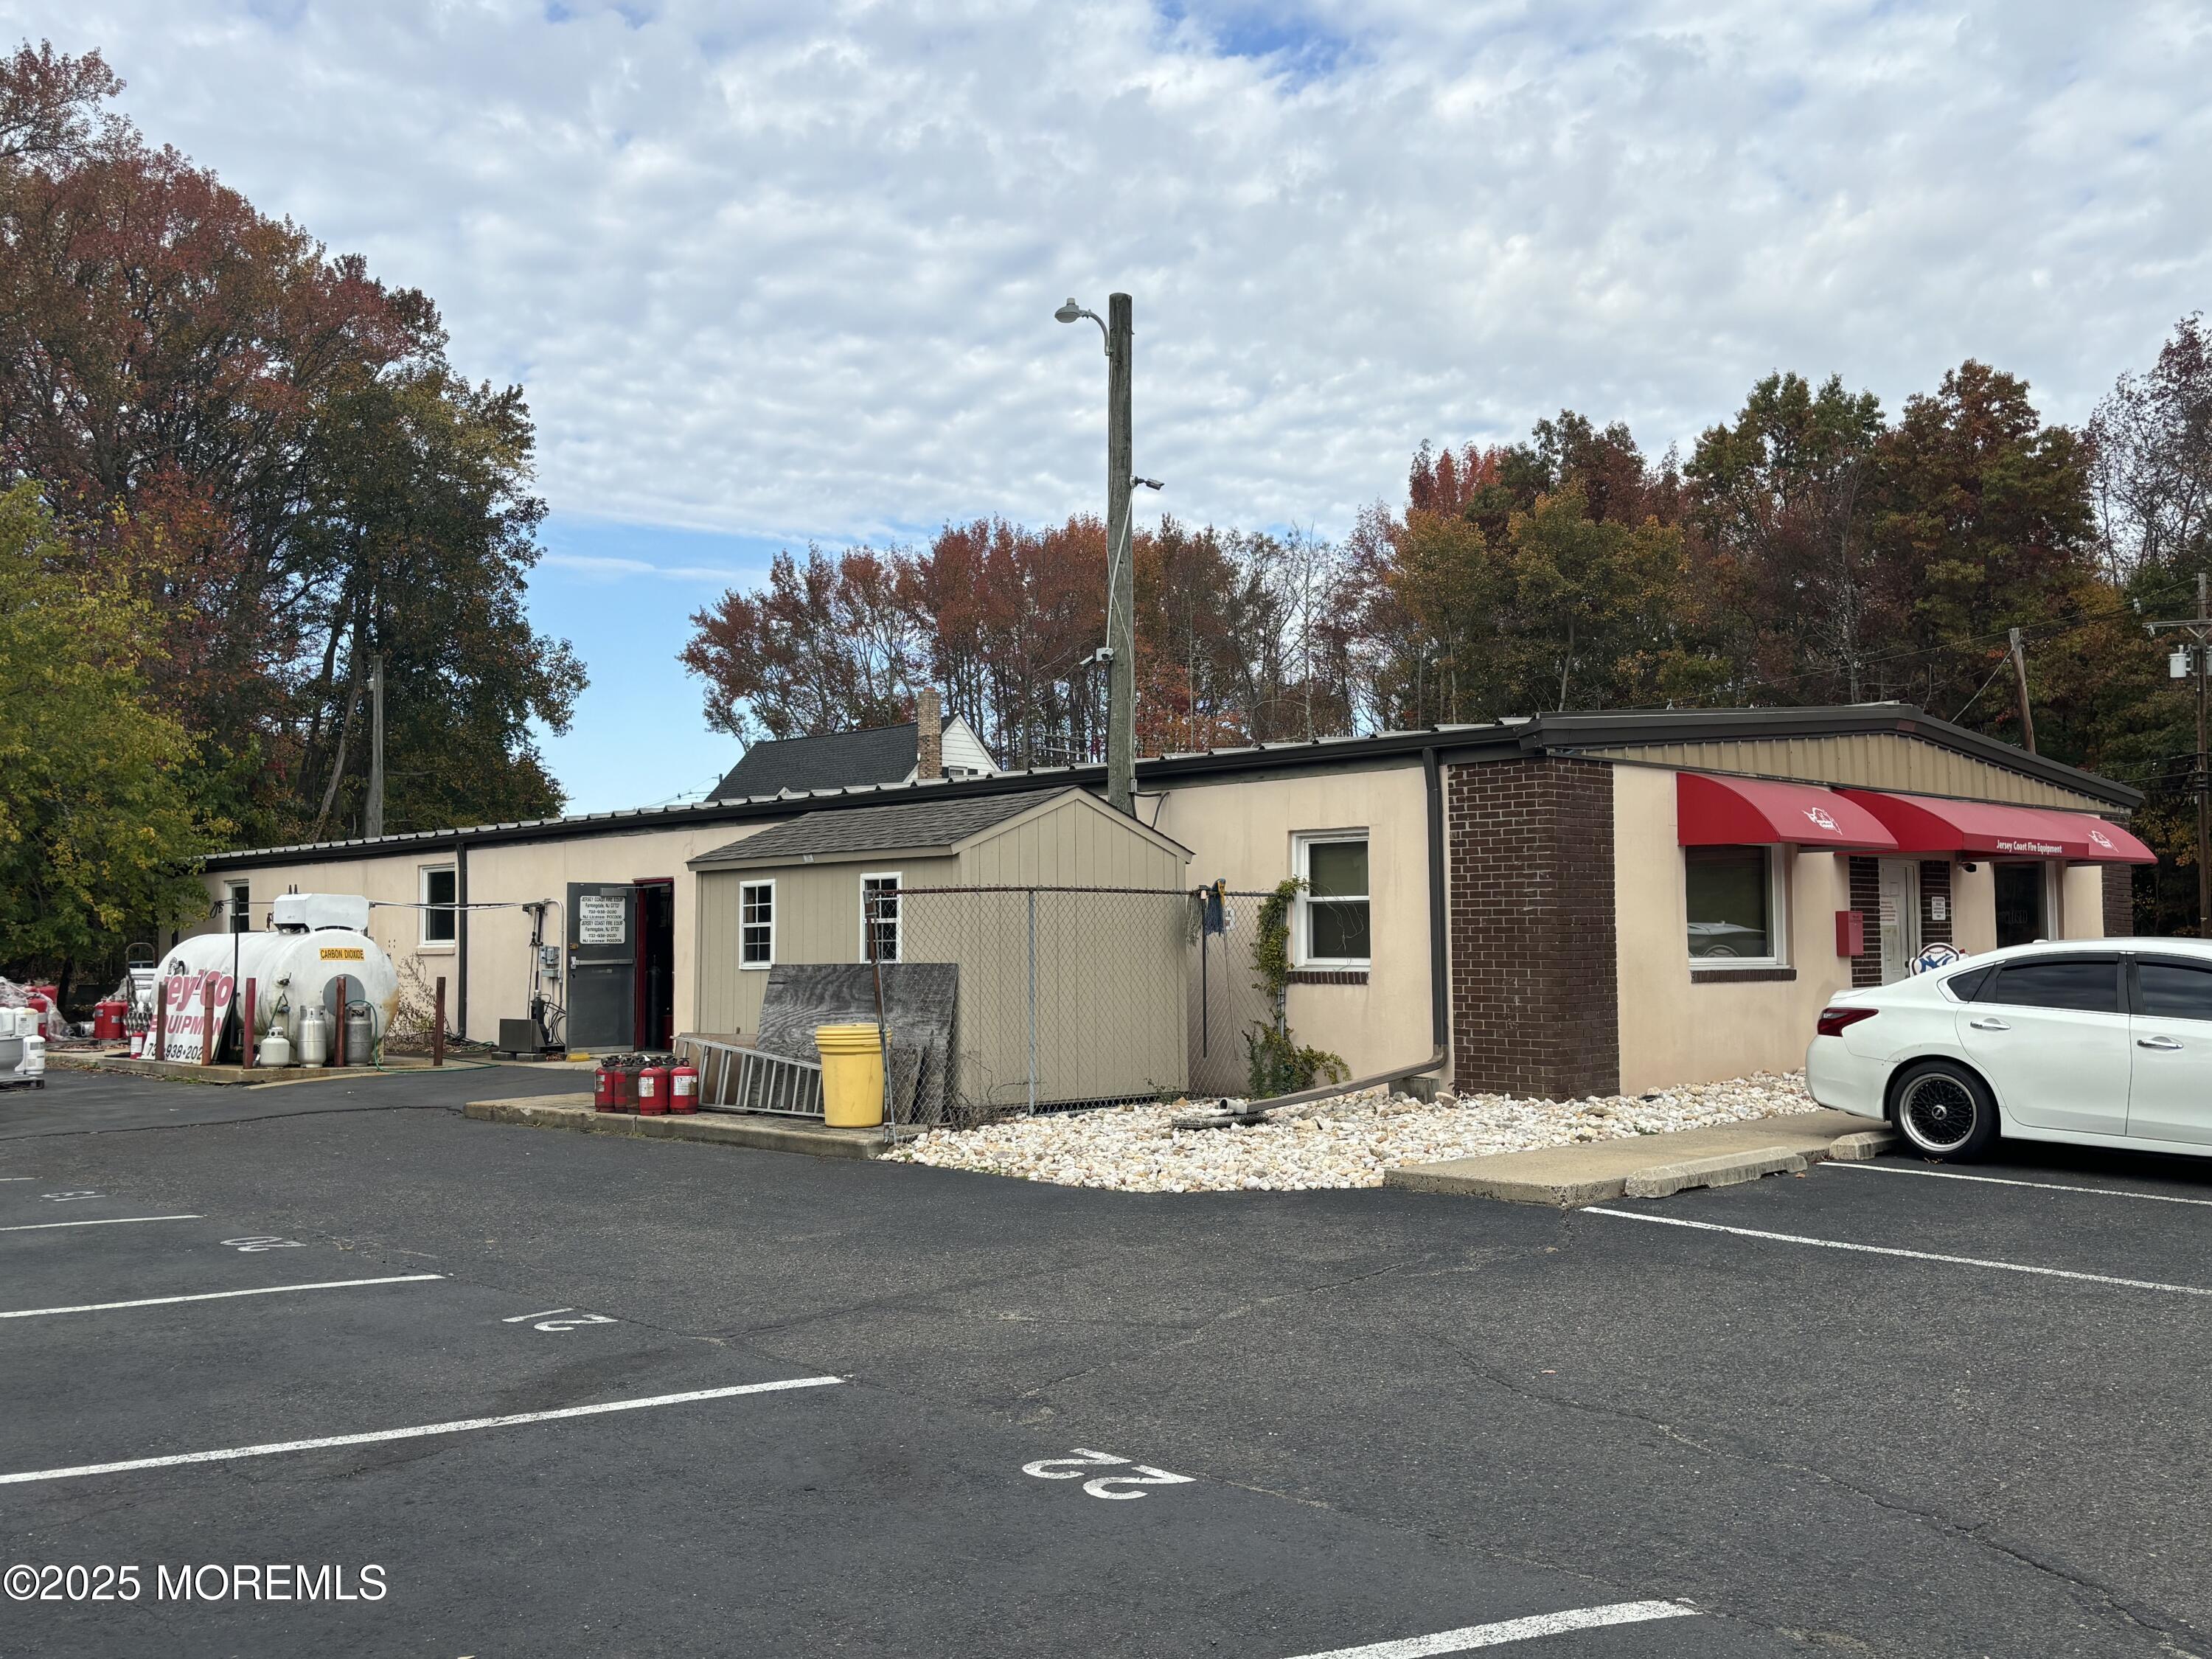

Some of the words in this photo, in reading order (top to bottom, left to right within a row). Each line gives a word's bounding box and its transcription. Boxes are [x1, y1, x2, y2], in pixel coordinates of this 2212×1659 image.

[1996, 839, 2012, 852] Jersey
[2014, 841, 2027, 851] Coast
[2028, 842, 2037, 852] Fire
[2037, 843, 2062, 855] Equipment
[320, 949, 343, 959] CARBON
[344, 949, 364, 959] DIOXIDE
[220, 1236, 307, 1252] 20
[501, 1307, 619, 1332] 21
[1021, 1447, 1197, 1500] 22
